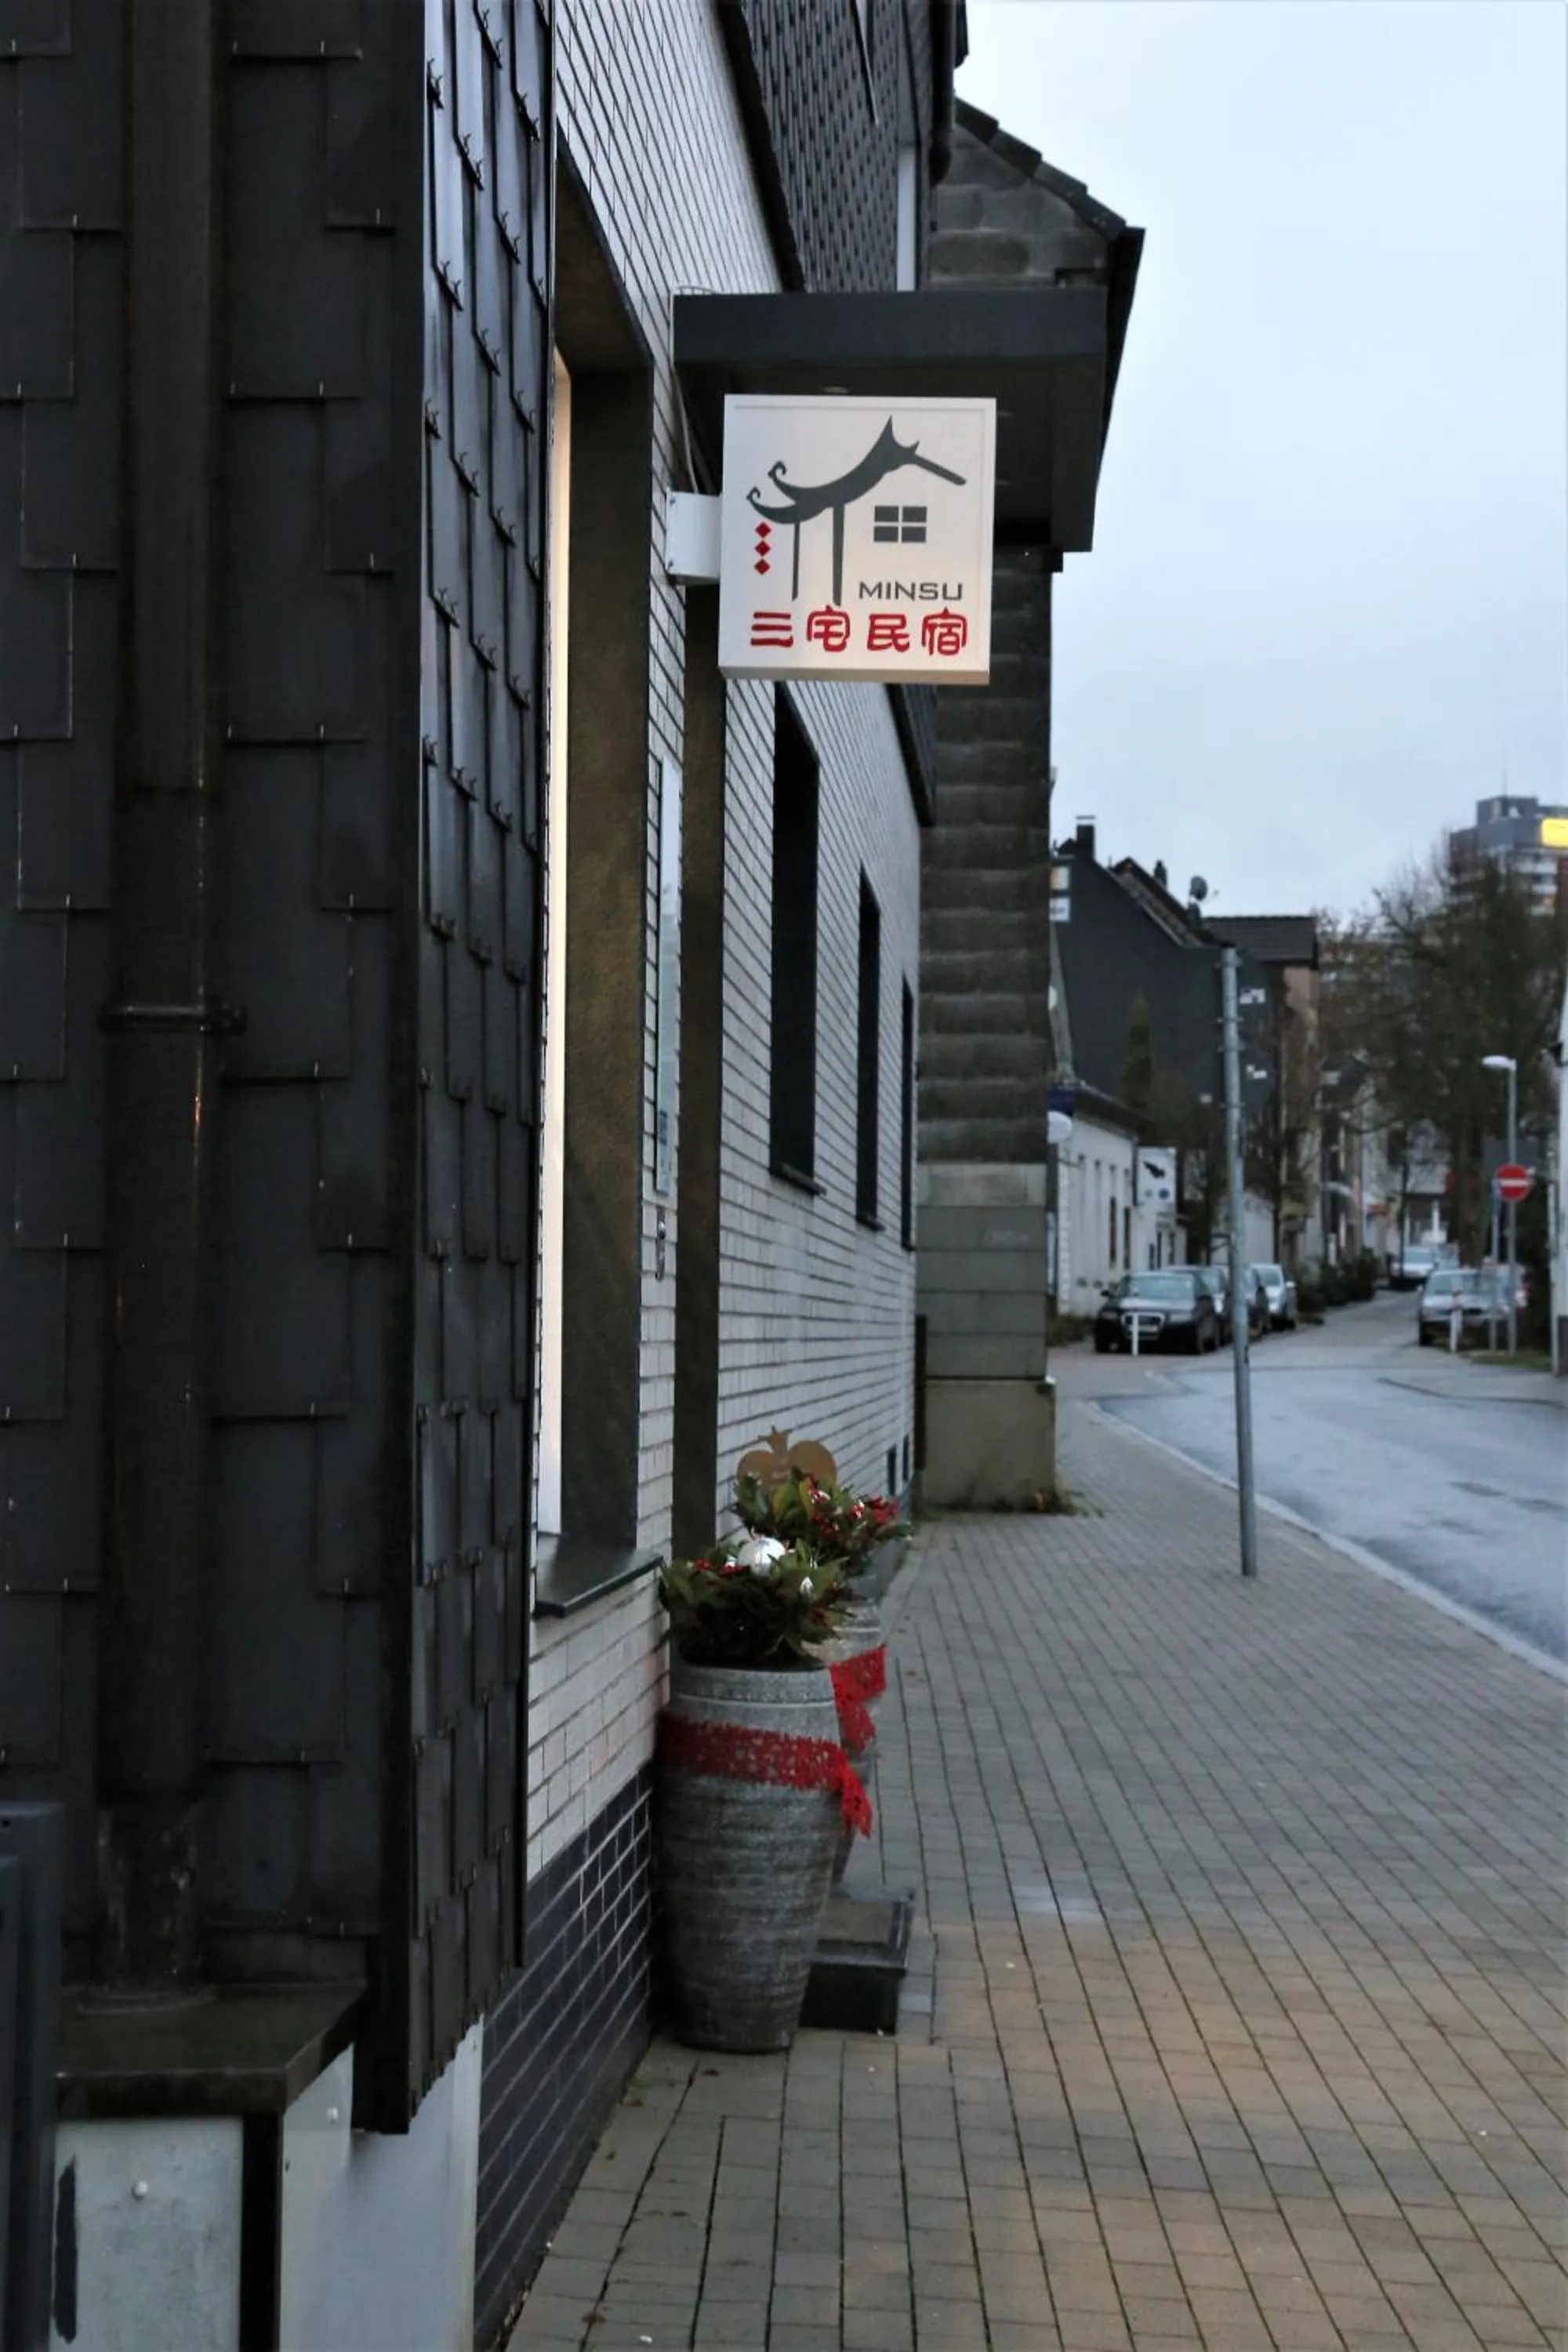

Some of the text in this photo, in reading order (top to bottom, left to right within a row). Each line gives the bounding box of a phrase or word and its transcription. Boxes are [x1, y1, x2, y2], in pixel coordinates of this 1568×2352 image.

[858, 581, 963, 601] MINSU
[750, 604, 968, 656] 三宅民宿
